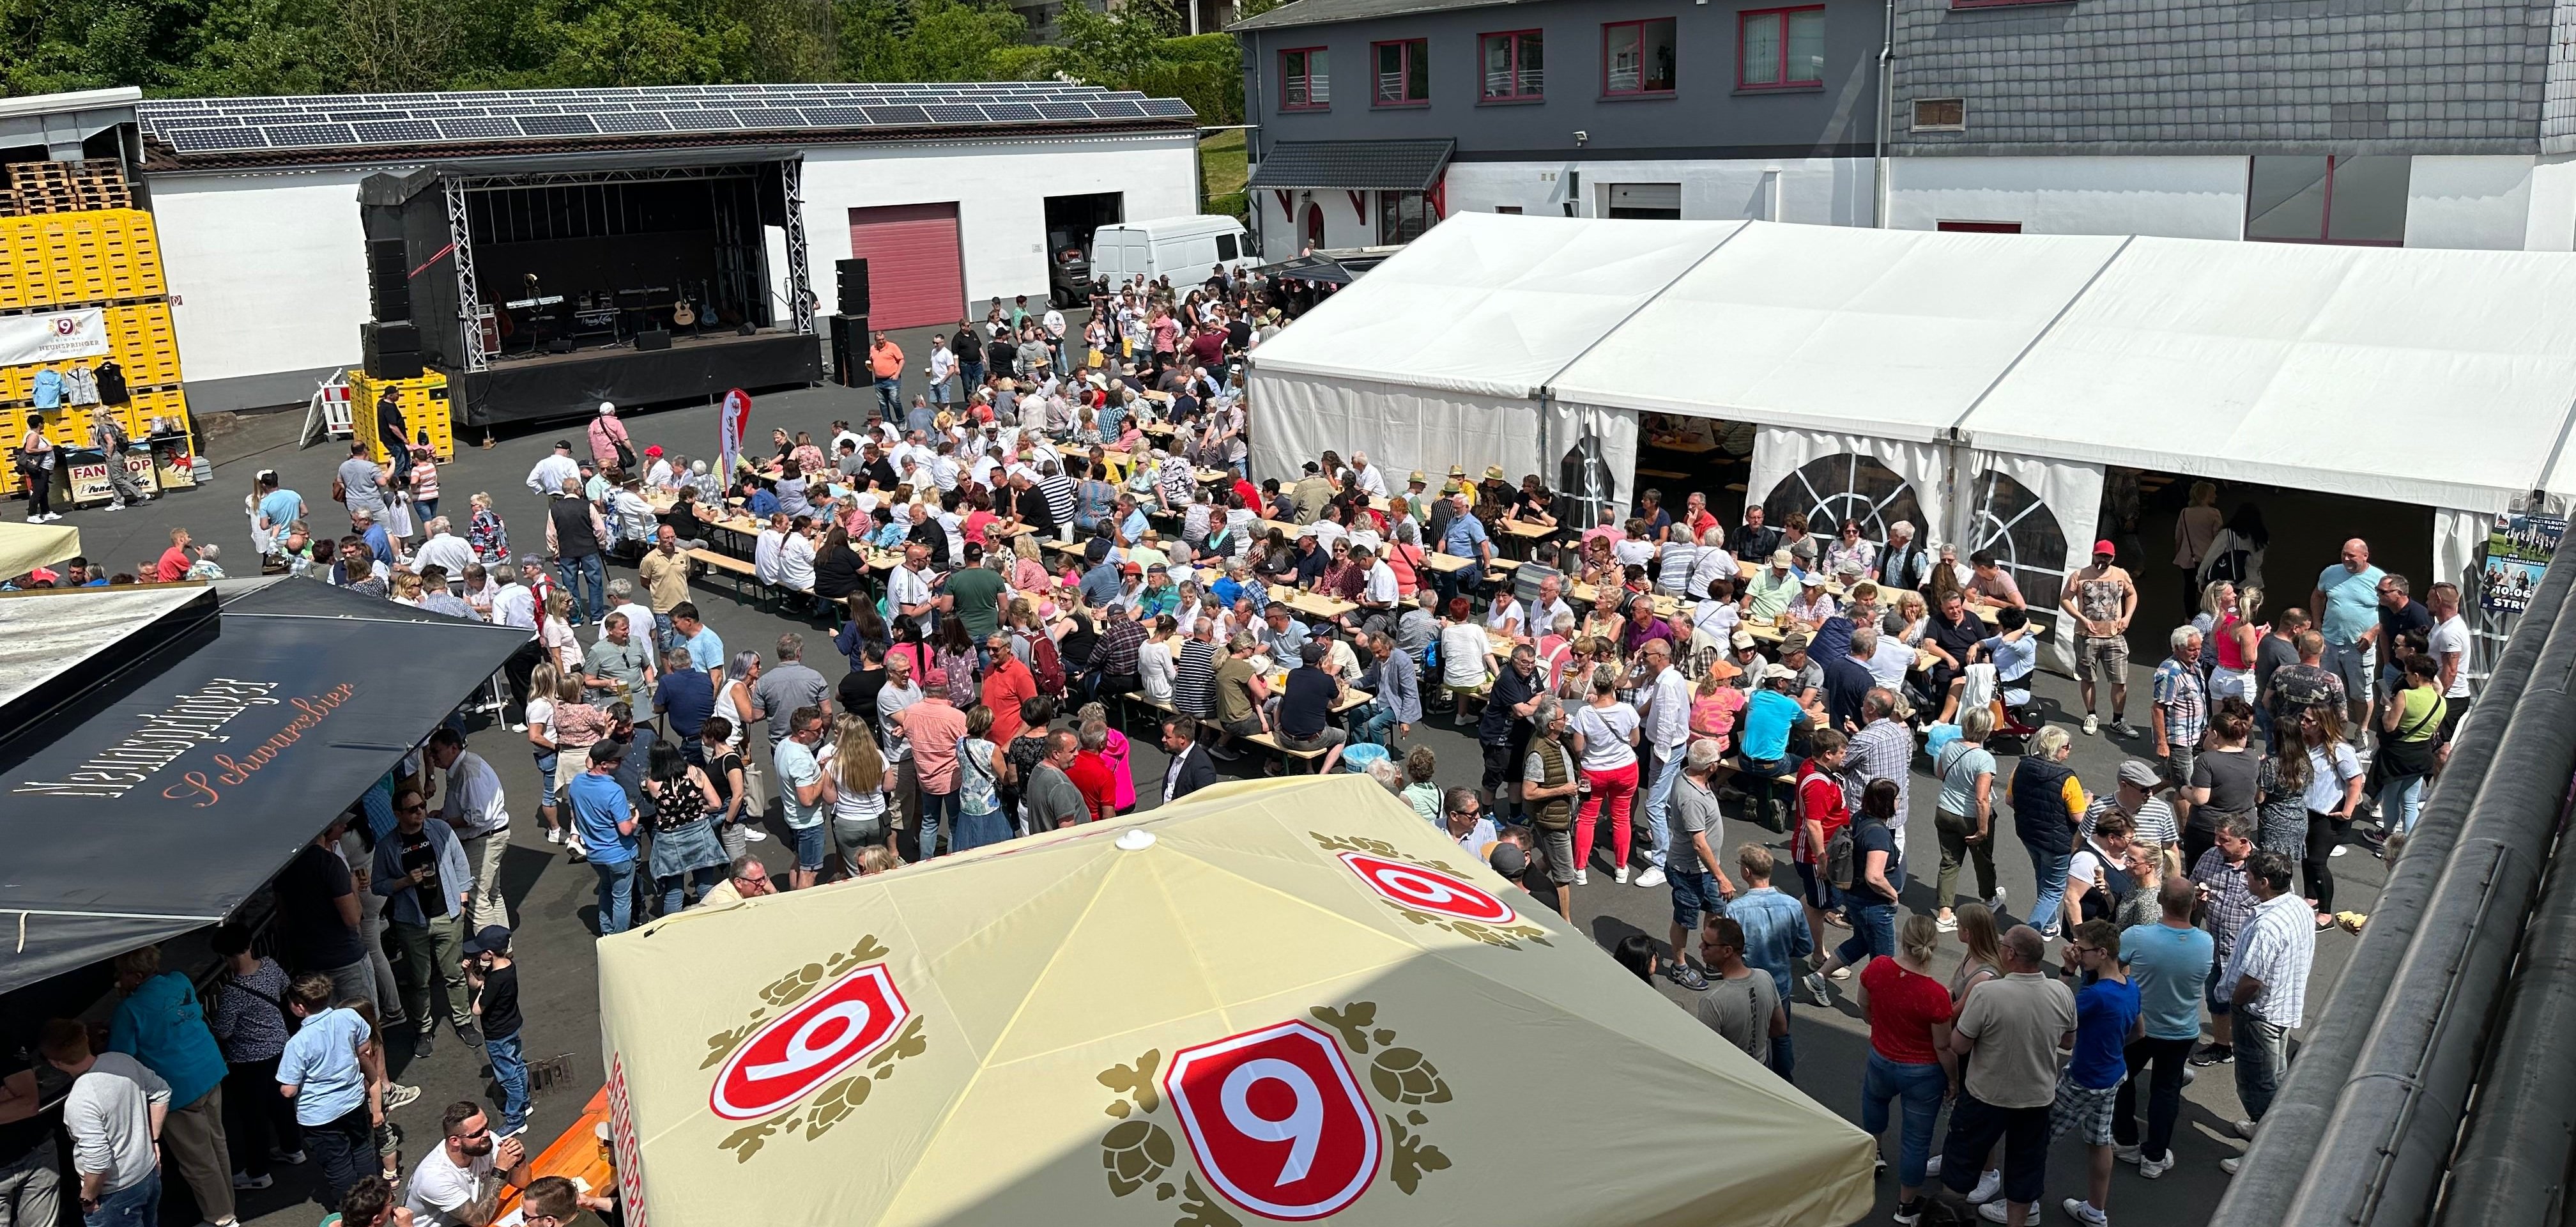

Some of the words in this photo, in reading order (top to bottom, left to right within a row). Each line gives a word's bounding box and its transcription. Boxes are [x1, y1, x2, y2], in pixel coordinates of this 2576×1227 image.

[39, 340, 100, 351] NEUNSPRINGER
[59, 320, 71, 333] 9
[162, 683, 355, 808] Schwarzbier
[1375, 868, 1489, 909] 9
[745, 999, 870, 1082] 9
[1220, 1058, 1324, 1187] 9
